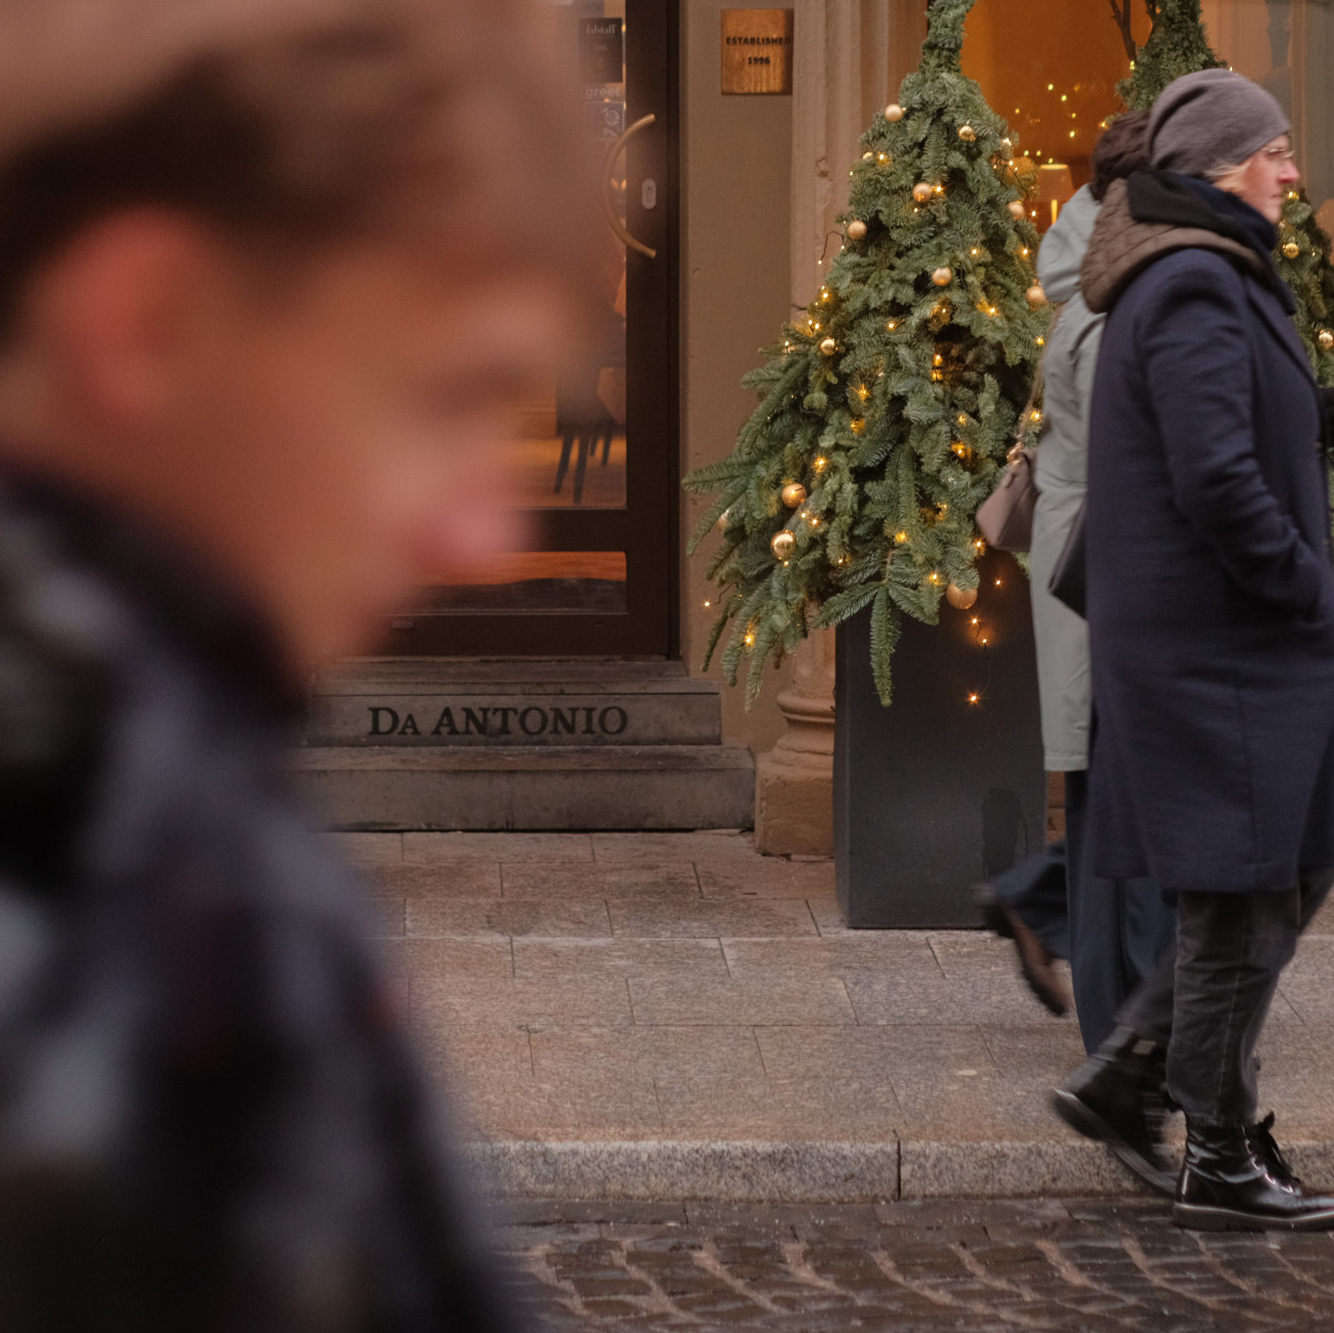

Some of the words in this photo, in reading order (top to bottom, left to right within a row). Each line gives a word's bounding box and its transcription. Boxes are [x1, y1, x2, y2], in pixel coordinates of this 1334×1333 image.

[725, 36, 791, 46] ESTABLISHED
[746, 56, 771, 66] 1996
[368, 706, 421, 735] DA
[430, 705, 629, 736] ANTONIO
